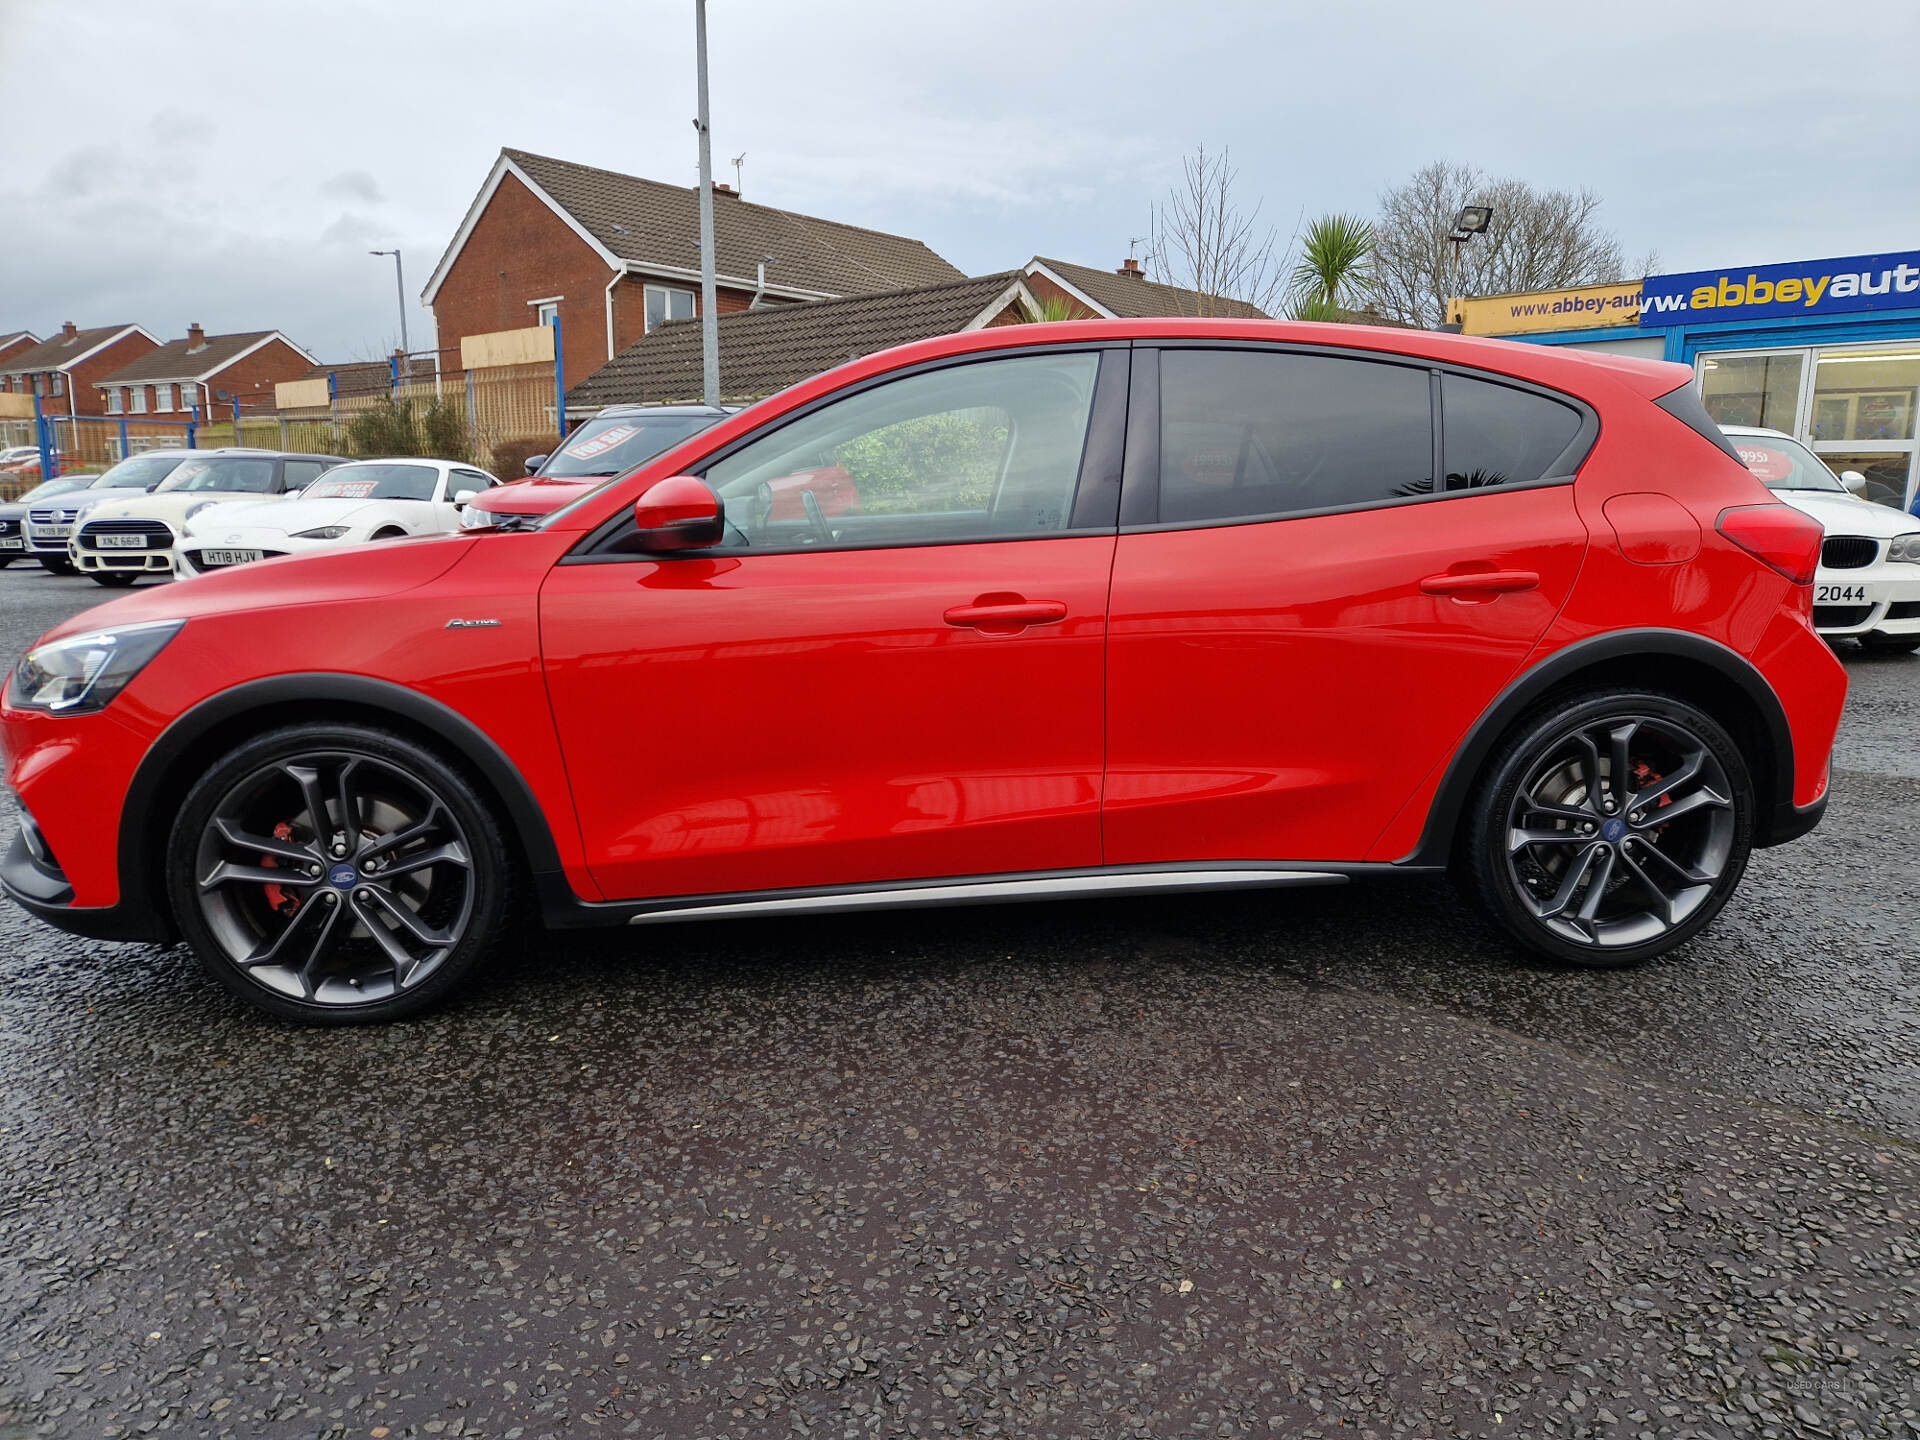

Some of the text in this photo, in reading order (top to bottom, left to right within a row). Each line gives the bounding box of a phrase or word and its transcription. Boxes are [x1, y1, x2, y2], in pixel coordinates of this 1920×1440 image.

[573, 441, 608, 457] FOR
[208, 551, 256, 563] HT18 HJV
[1817, 586, 1865, 601] 2044
